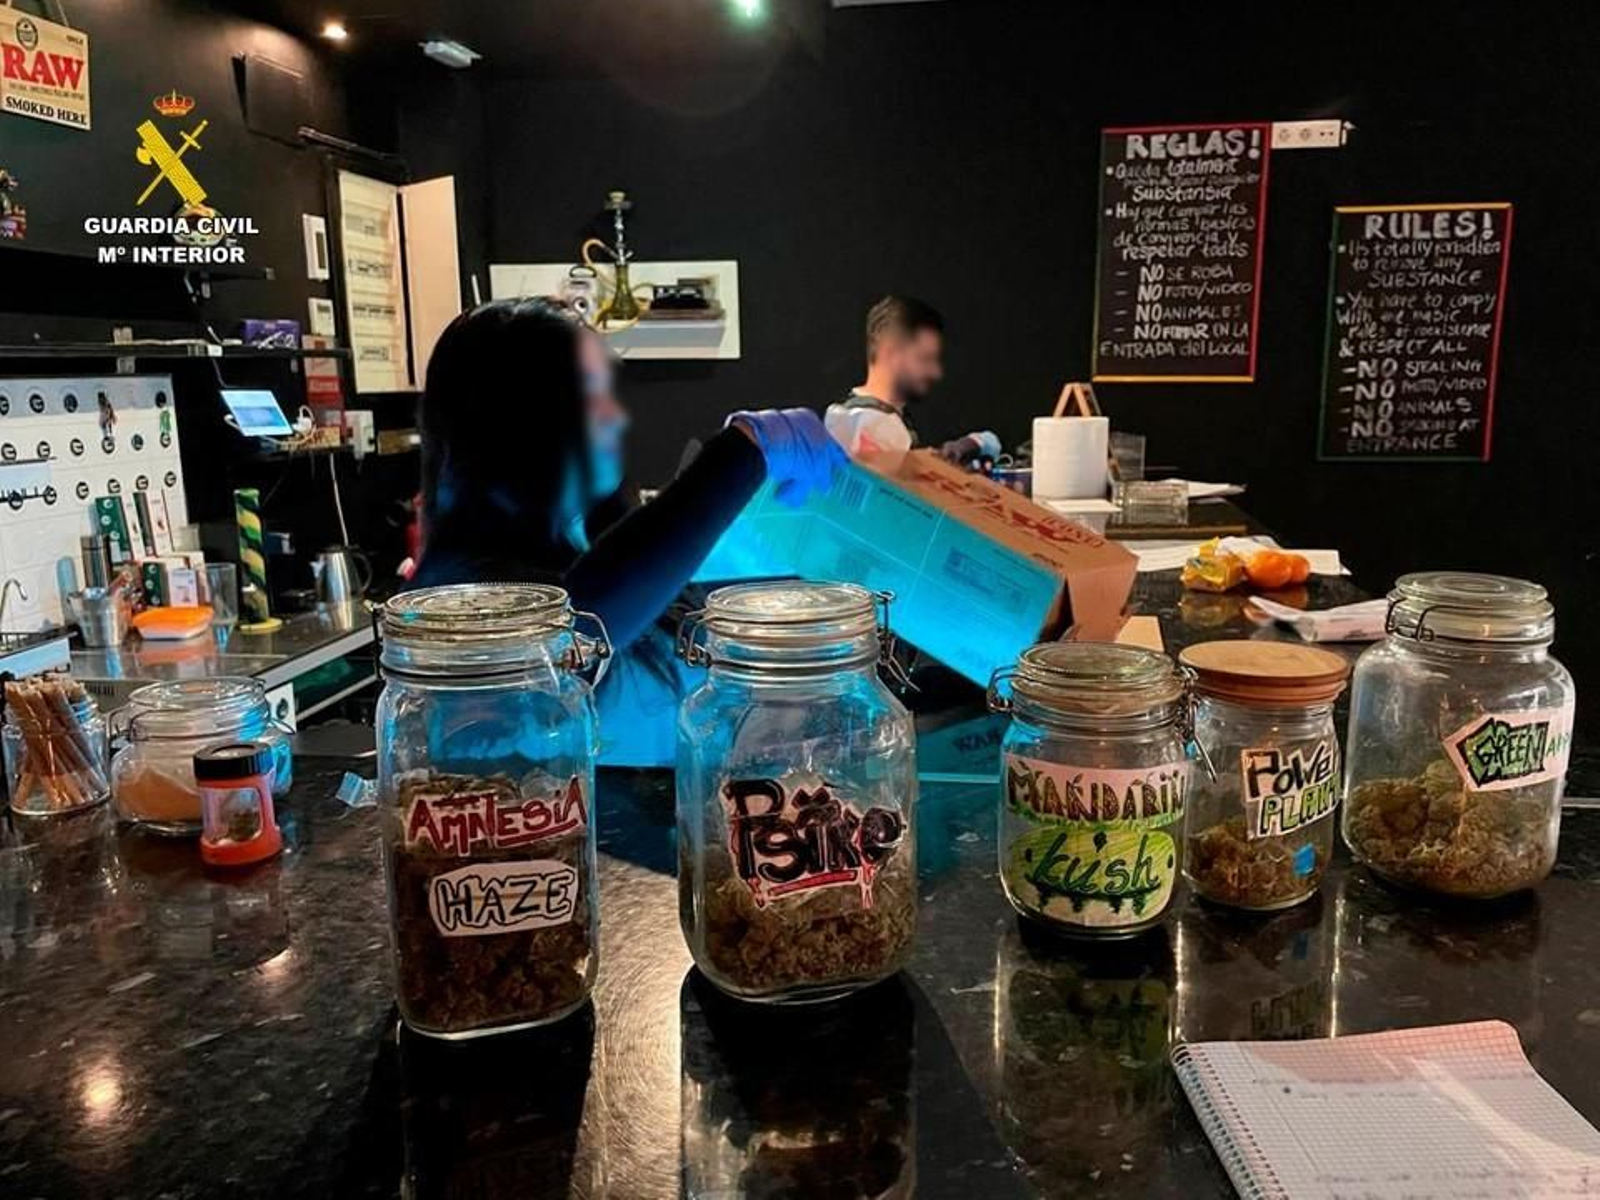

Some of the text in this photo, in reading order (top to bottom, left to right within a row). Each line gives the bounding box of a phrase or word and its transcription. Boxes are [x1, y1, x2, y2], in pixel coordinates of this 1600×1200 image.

[1, 42, 84, 90] RAW
[6, 96, 86, 125] SMOKED HERE
[1126, 129, 1261, 160] REGLAS!
[1365, 211, 1493, 239] RULES!
[1140, 264, 1164, 283] NO
[1368, 270, 1482, 288] SUBSTANCE
[1138, 284, 1162, 301] NO
[1136, 303, 1162, 321] NO
[1134, 324, 1161, 340] NO
[1101, 341, 1175, 358] ENTRADA
[1430, 340, 1467, 354] ALL
[1358, 358, 1398, 378] NO
[1354, 380, 1395, 400] NO
[1353, 400, 1393, 419] NO
[1351, 419, 1393, 438] NO
[435, 869, 575, 931] HAZE
